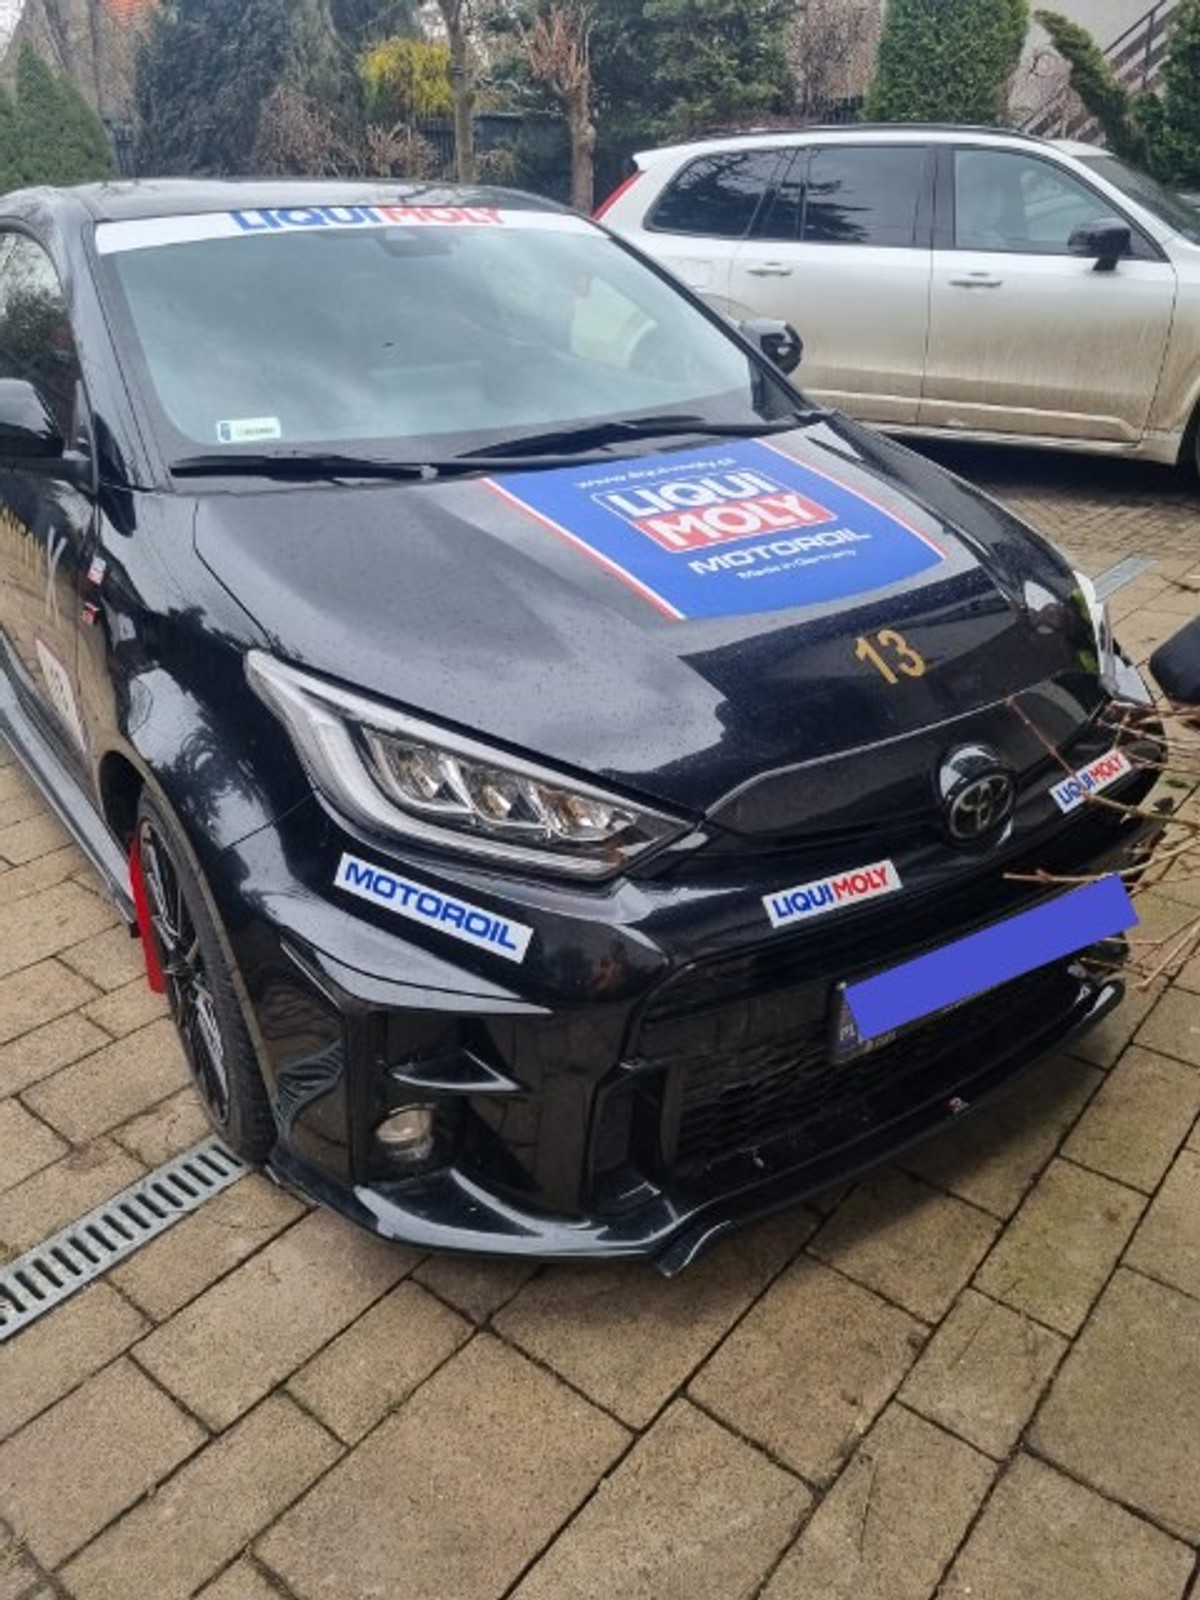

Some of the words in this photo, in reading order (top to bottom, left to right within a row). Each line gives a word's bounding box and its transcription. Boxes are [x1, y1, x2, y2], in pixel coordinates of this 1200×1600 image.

[607, 472, 780, 518] LIQUI
[645, 494, 819, 547] MOLY
[687, 527, 873, 576] MOTOROIL
[854, 629, 926, 684] 13
[344, 861, 518, 950] MOTOROIL
[771, 866, 889, 918] LIQUIMOLY
